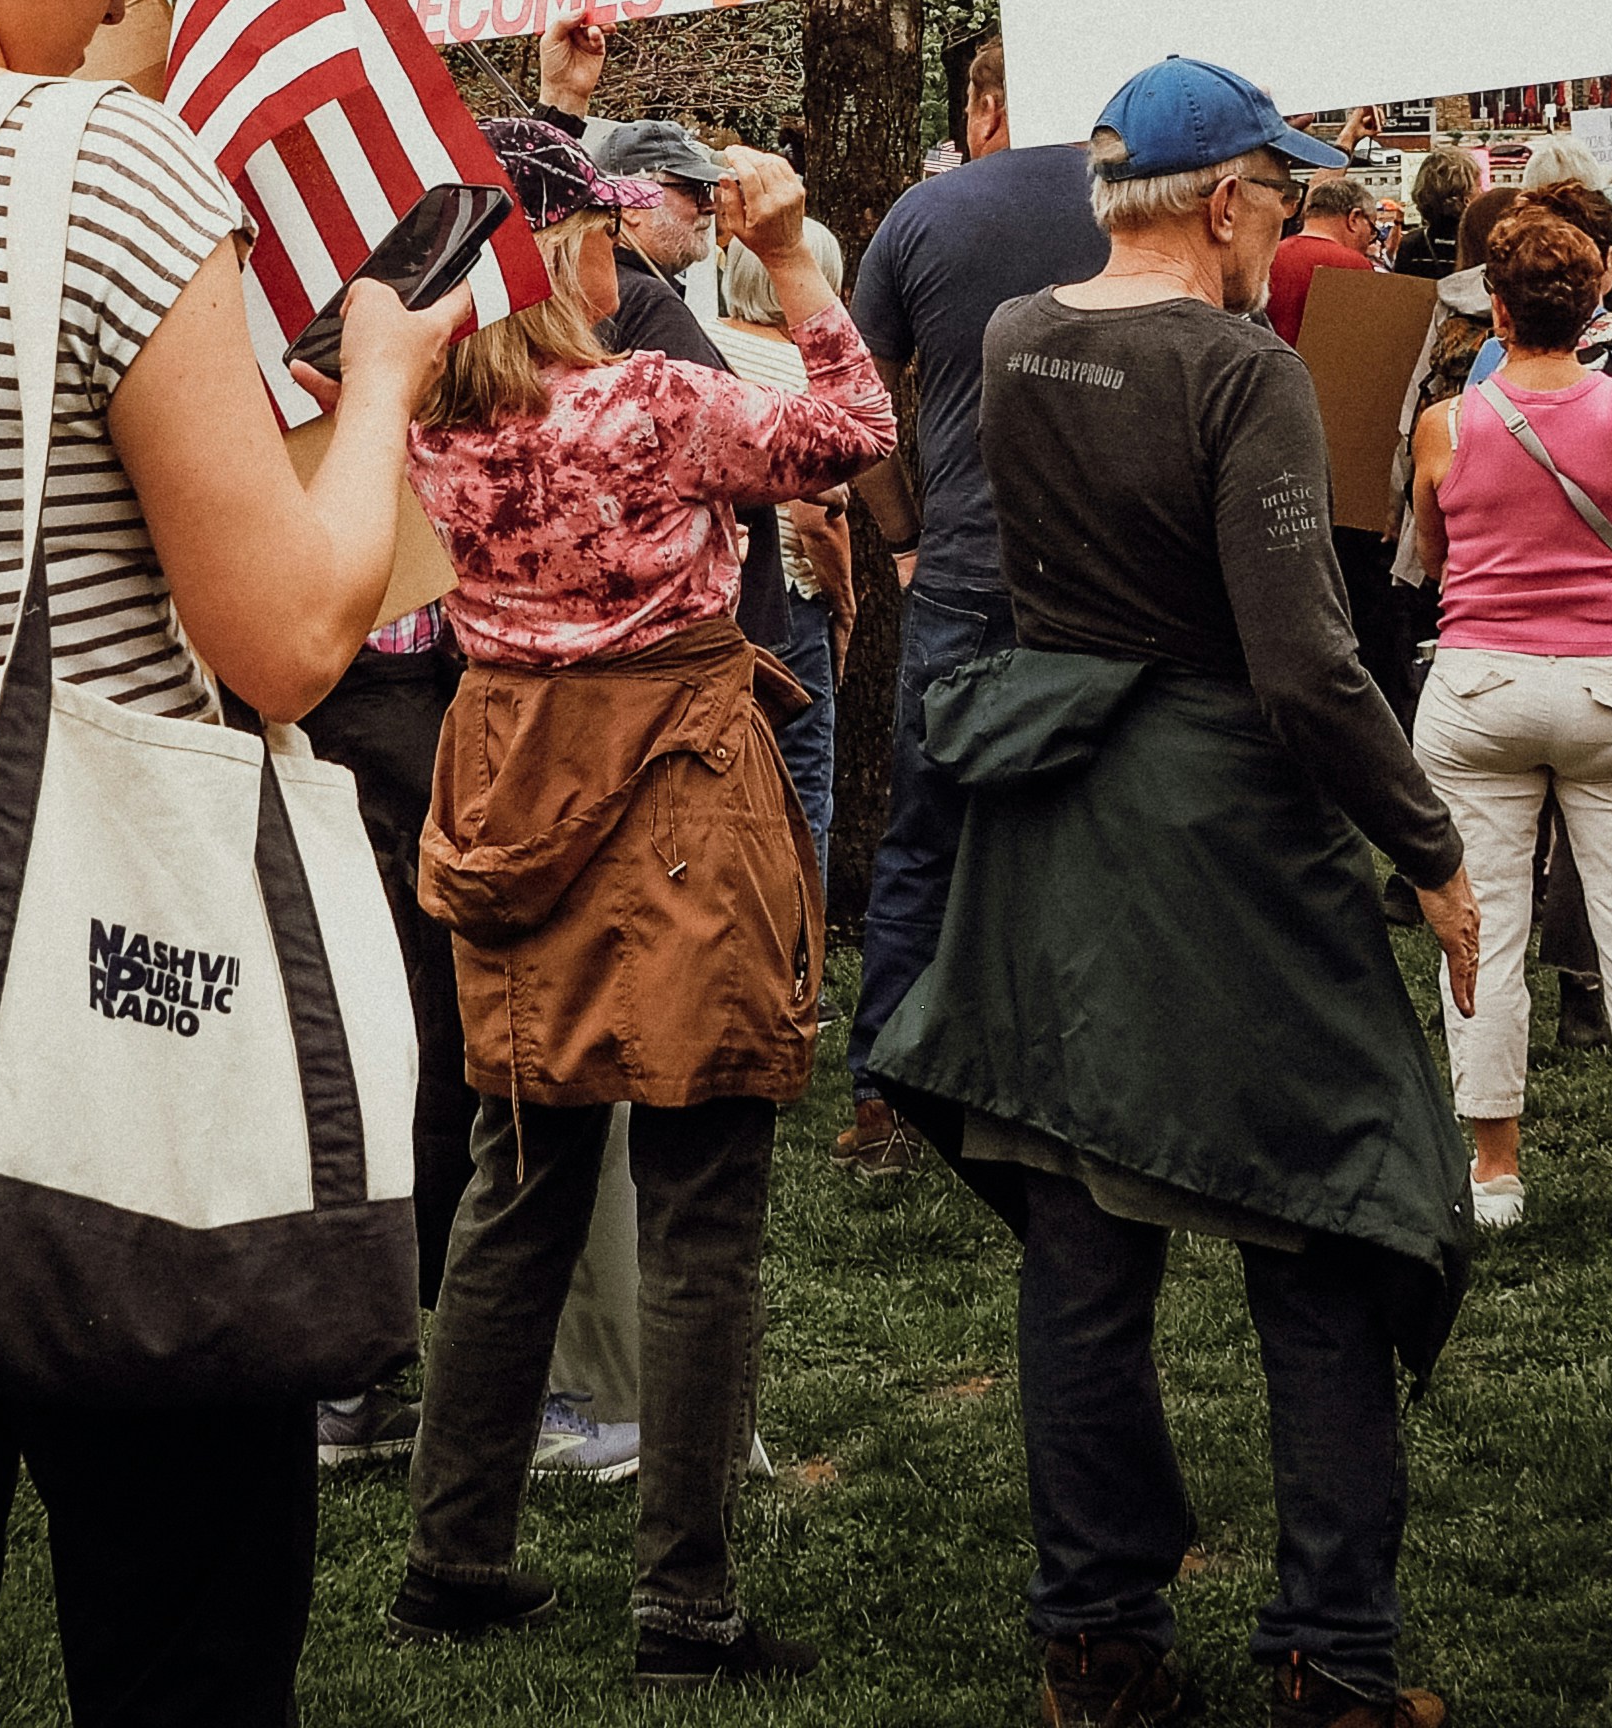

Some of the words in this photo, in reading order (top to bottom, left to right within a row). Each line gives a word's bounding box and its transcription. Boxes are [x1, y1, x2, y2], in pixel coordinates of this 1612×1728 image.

[1006, 352, 1126, 390] #VALORYPROUD
[1267, 516, 1318, 538] VALUE
[1276, 503, 1308, 520] HAS
[89, 963, 200, 1038] RADIO
[105, 952, 234, 1014] PUBLIC
